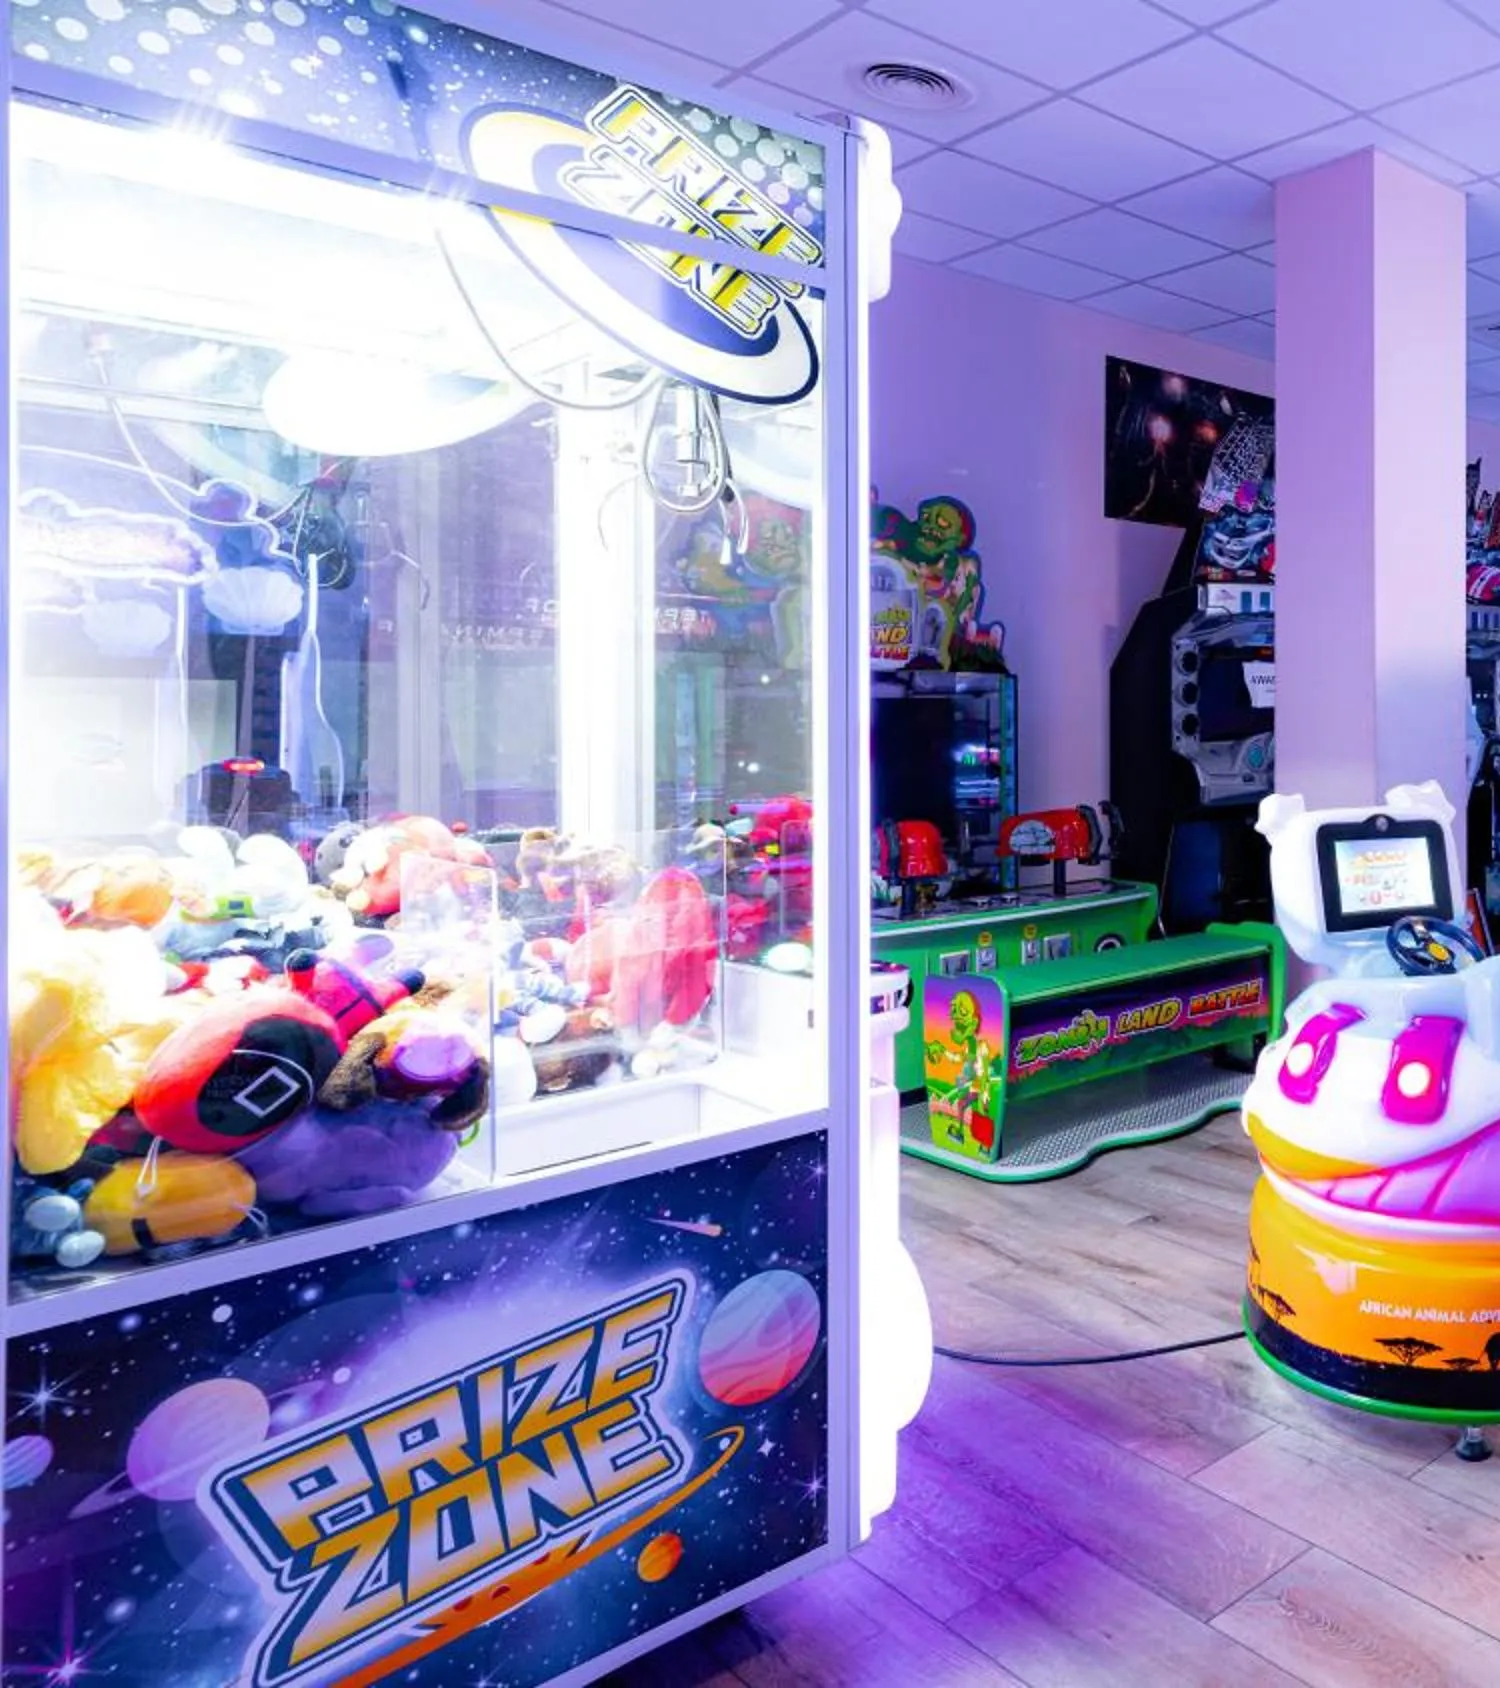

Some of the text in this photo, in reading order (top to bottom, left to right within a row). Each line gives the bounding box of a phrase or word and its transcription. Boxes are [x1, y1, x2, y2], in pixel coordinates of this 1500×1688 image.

[597, 93, 822, 297] PRIZE
[1117, 998, 1181, 1036] LAND
[1359, 1299, 1412, 1319] AFRICAN
[1415, 1306, 1466, 1323] ANIMAL
[225, 1288, 676, 1556] PRIZE
[282, 1398, 676, 1668] ZONE
